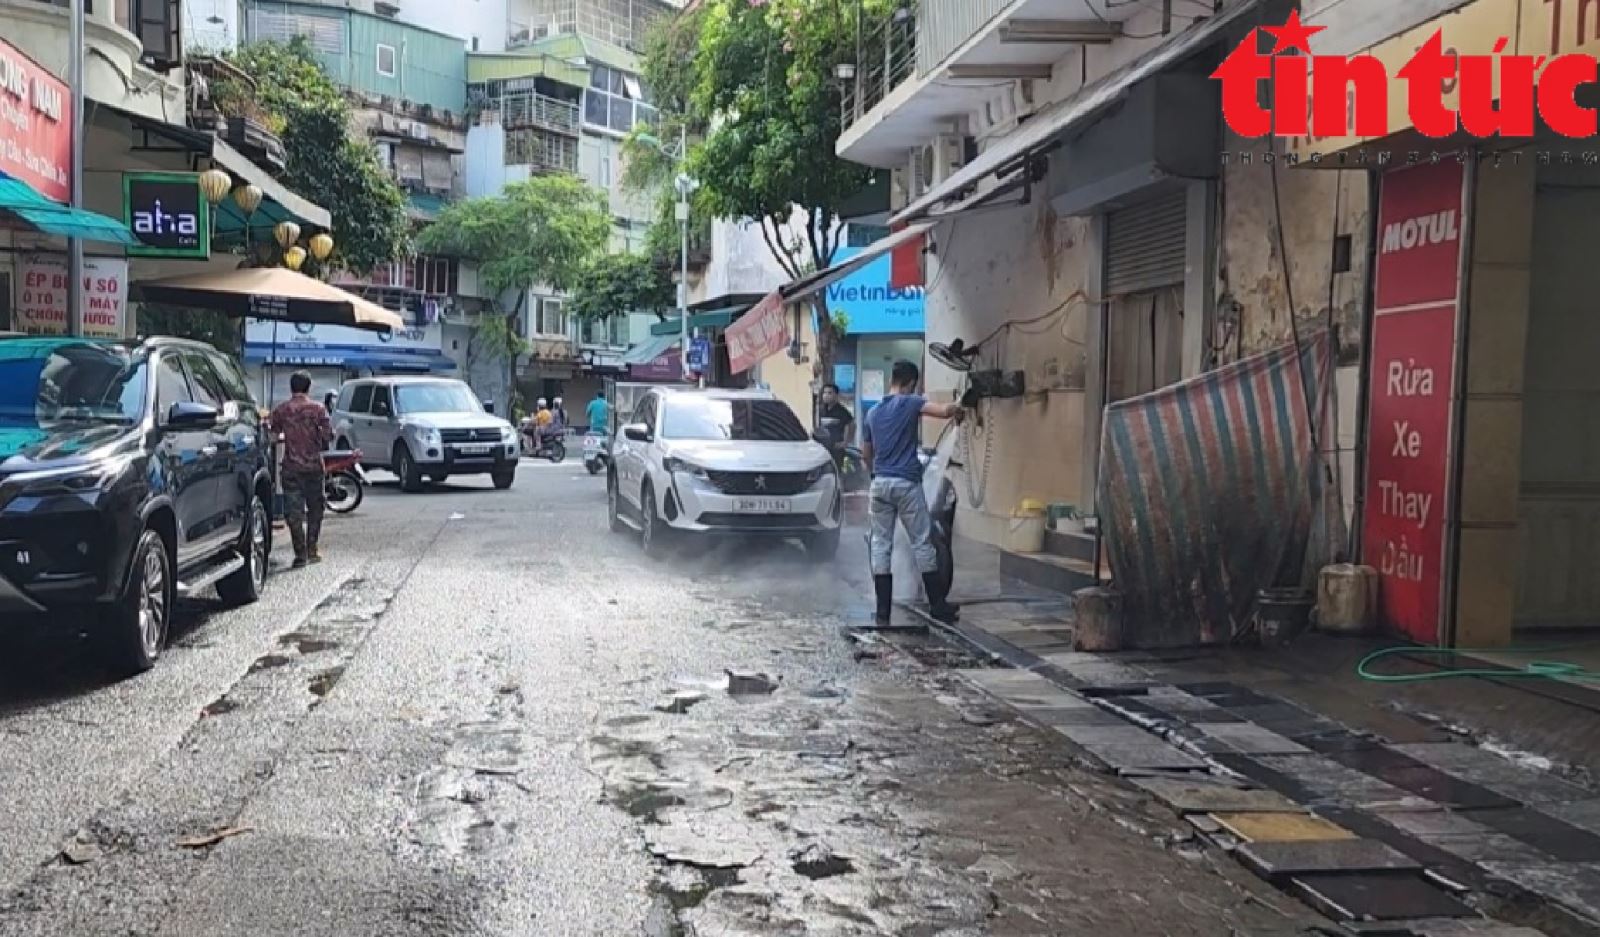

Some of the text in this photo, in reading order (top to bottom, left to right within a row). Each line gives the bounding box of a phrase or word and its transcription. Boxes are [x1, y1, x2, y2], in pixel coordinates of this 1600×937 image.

[32, 78, 62, 123] NAM
[134, 198, 197, 234] aha
[1382, 209, 1458, 254] MOTUL
[1386, 357, 1434, 397] Rửa
[1392, 421, 1421, 458] Xe
[1378, 479, 1432, 530] Thay
